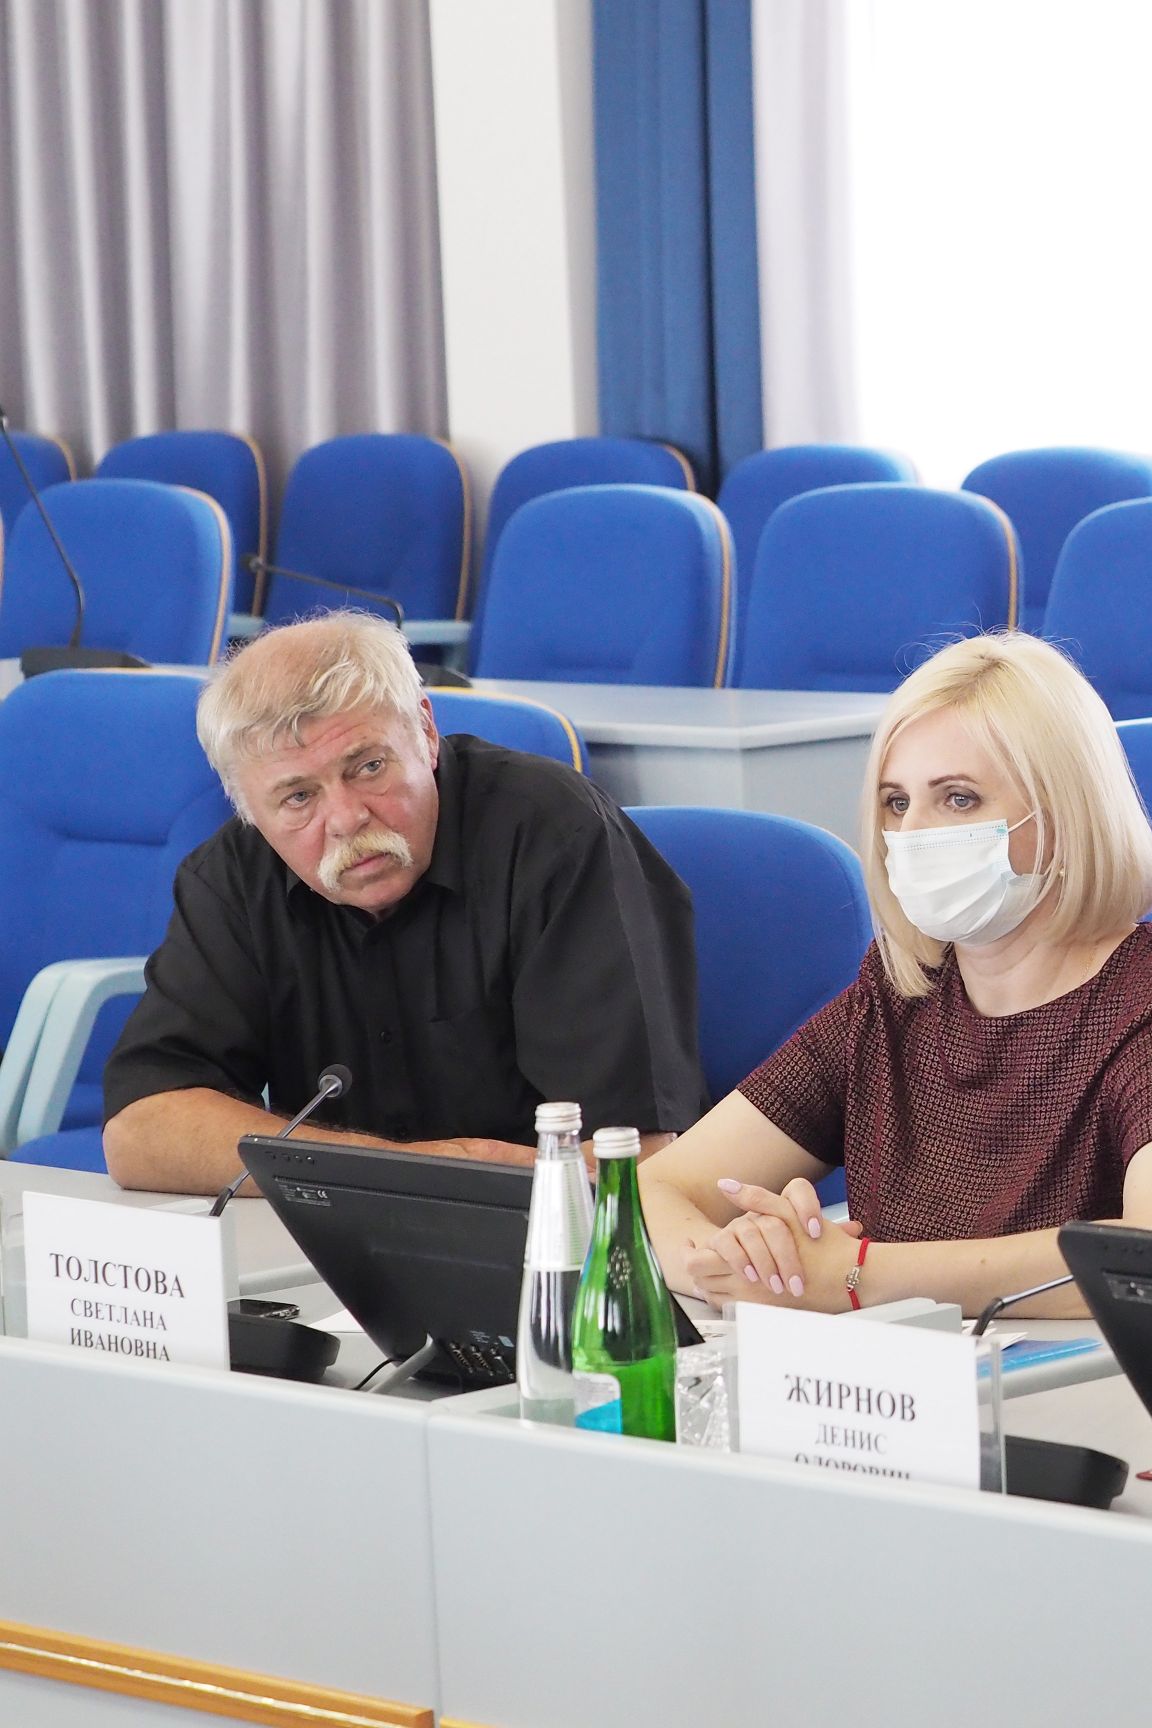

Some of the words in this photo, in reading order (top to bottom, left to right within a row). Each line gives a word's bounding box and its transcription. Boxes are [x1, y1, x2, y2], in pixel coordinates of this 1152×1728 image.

[49, 1252, 185, 1299] ТОЛСТОВА
[70, 1297, 167, 1331] СВЕТЛАНА
[70, 1327, 171, 1362] ИВАНОВНА
[784, 1373, 916, 1422] ЖИРНОВ
[815, 1423, 888, 1454] ДЕНИС
